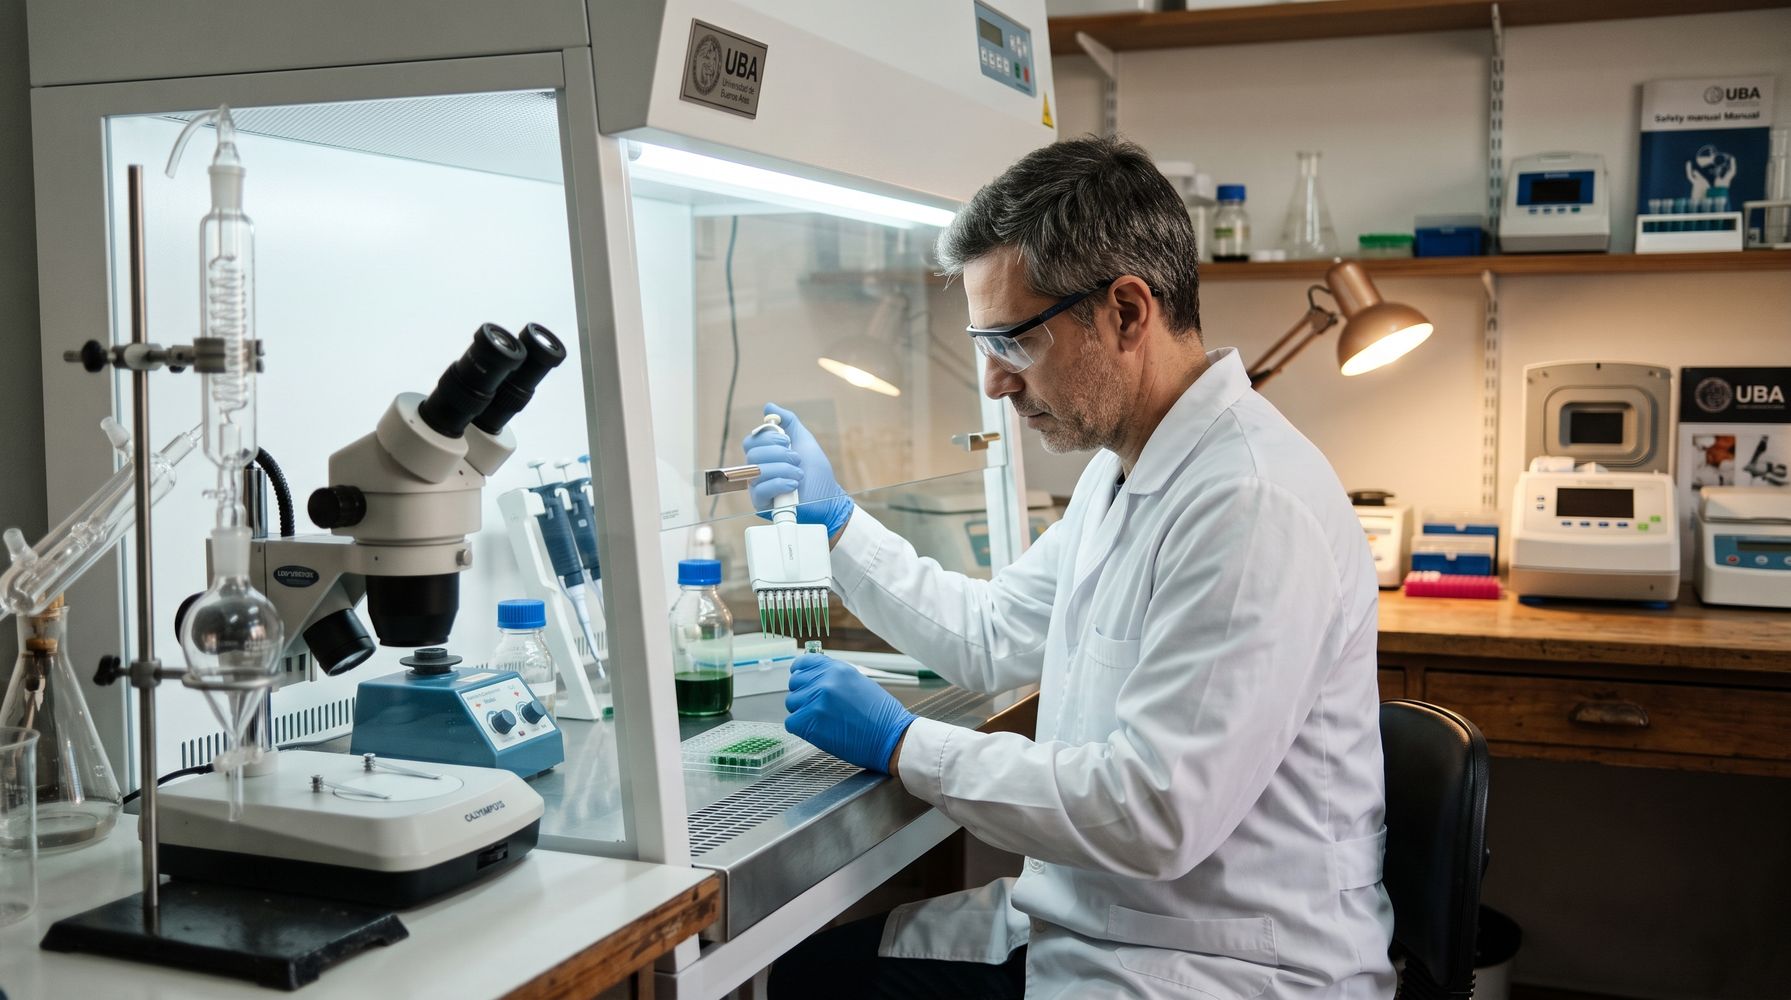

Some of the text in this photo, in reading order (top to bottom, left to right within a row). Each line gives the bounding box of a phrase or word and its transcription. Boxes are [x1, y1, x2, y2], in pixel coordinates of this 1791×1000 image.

[725, 48, 757, 82] UBA
[1726, 87, 1760, 100] UBA
[1655, 113, 1684, 124] Safety
[1736, 385, 1785, 403] UBA
